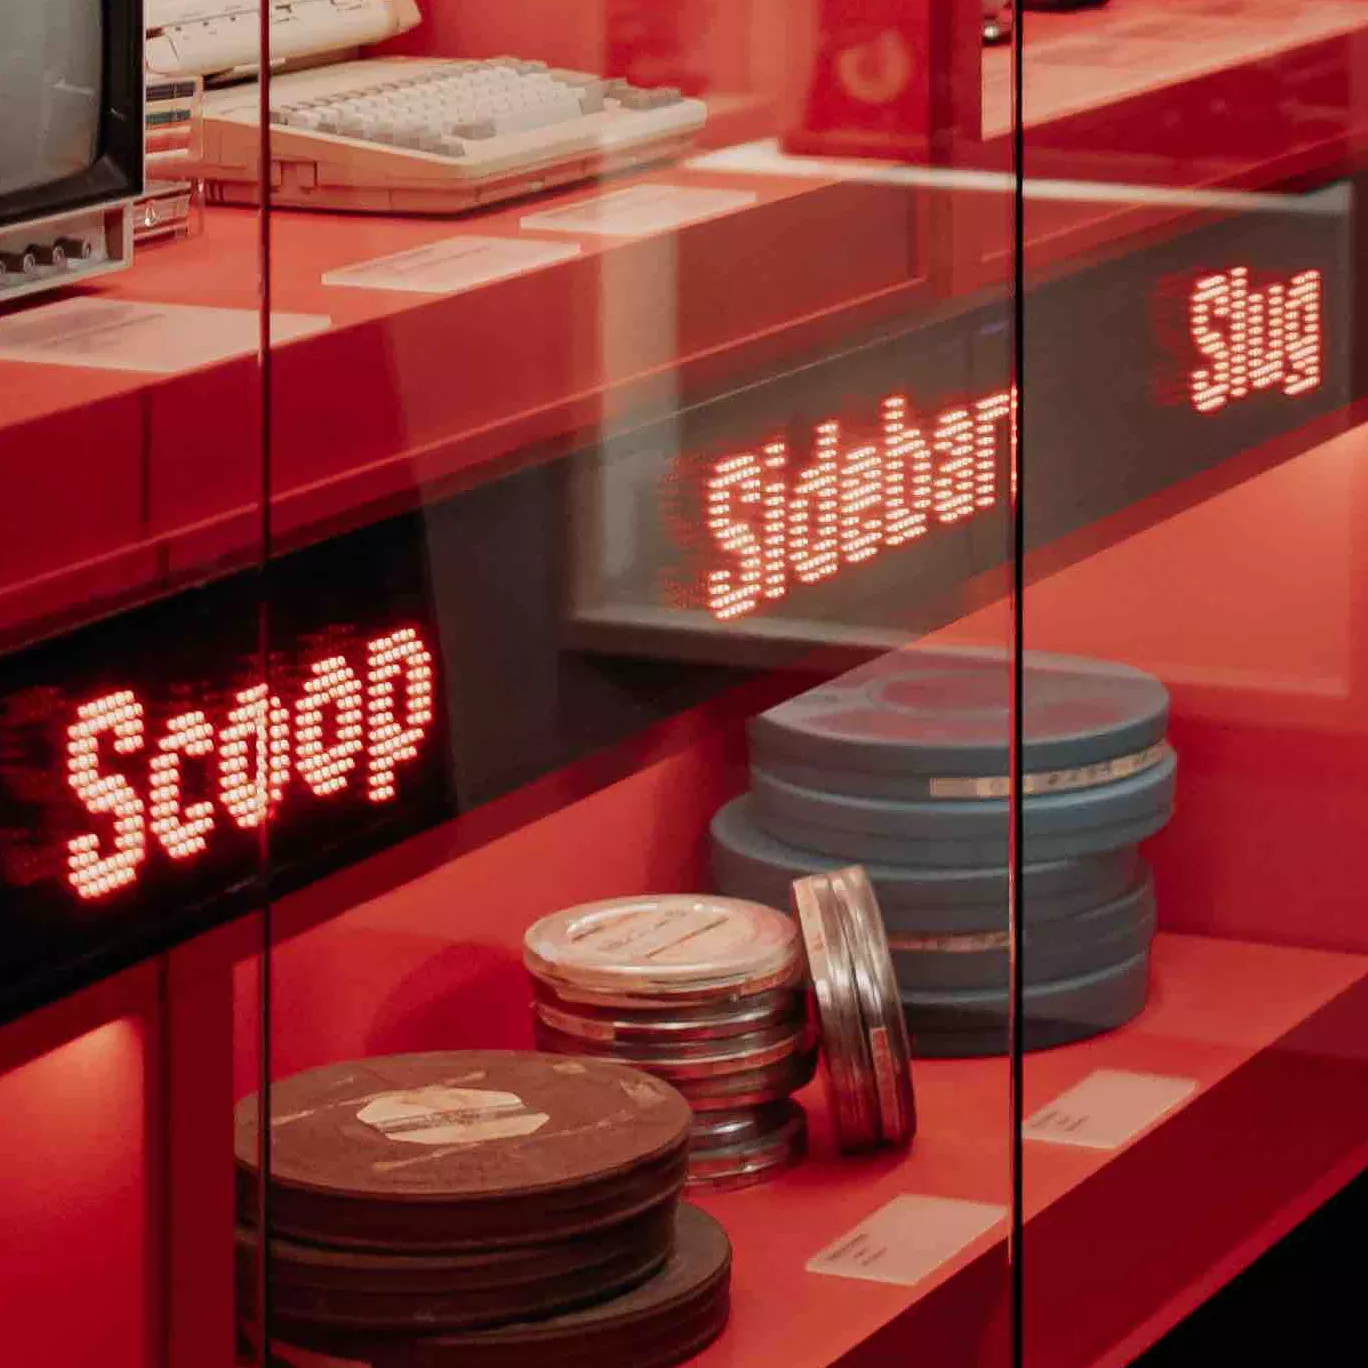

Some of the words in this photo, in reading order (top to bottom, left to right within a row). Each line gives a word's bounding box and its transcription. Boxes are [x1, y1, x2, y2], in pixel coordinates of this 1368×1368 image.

[1191, 266, 1320, 412] Slug
[709, 394, 1012, 620] Sidebar
[67, 628, 432, 899] Scoop
